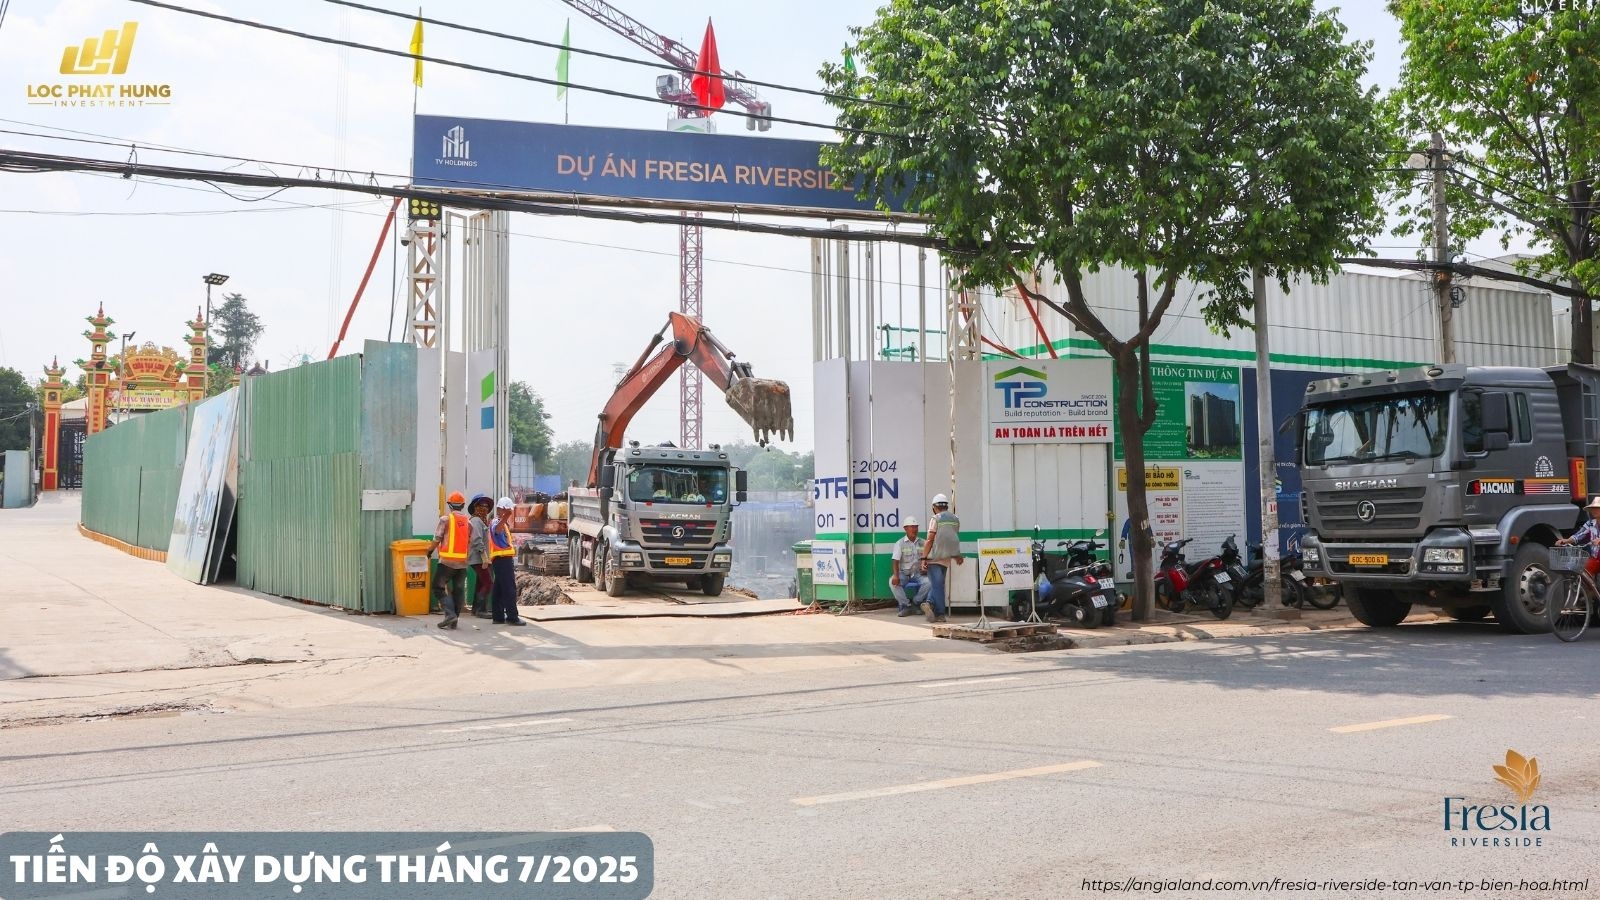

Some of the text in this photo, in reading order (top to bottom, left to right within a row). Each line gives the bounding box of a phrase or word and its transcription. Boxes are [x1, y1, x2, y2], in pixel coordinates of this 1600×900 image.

[445, 159, 478, 167] HOLDINGS
[557, 152, 855, 191] DỰ ÁN FRESIA RIVERSID
[1150, 364, 1233, 381] THÔNG TIN DỰ ÁN
[1023, 400, 1108, 408] CONSTRUCTION
[1004, 409, 1022, 417] Build
[1024, 410, 1061, 418] reputation
[995, 423, 1108, 438] AN TOÀN LÀ TRÊN HẾT
[860, 460, 897, 473] 2004
[1335, 479, 1397, 490] SHACMAN
